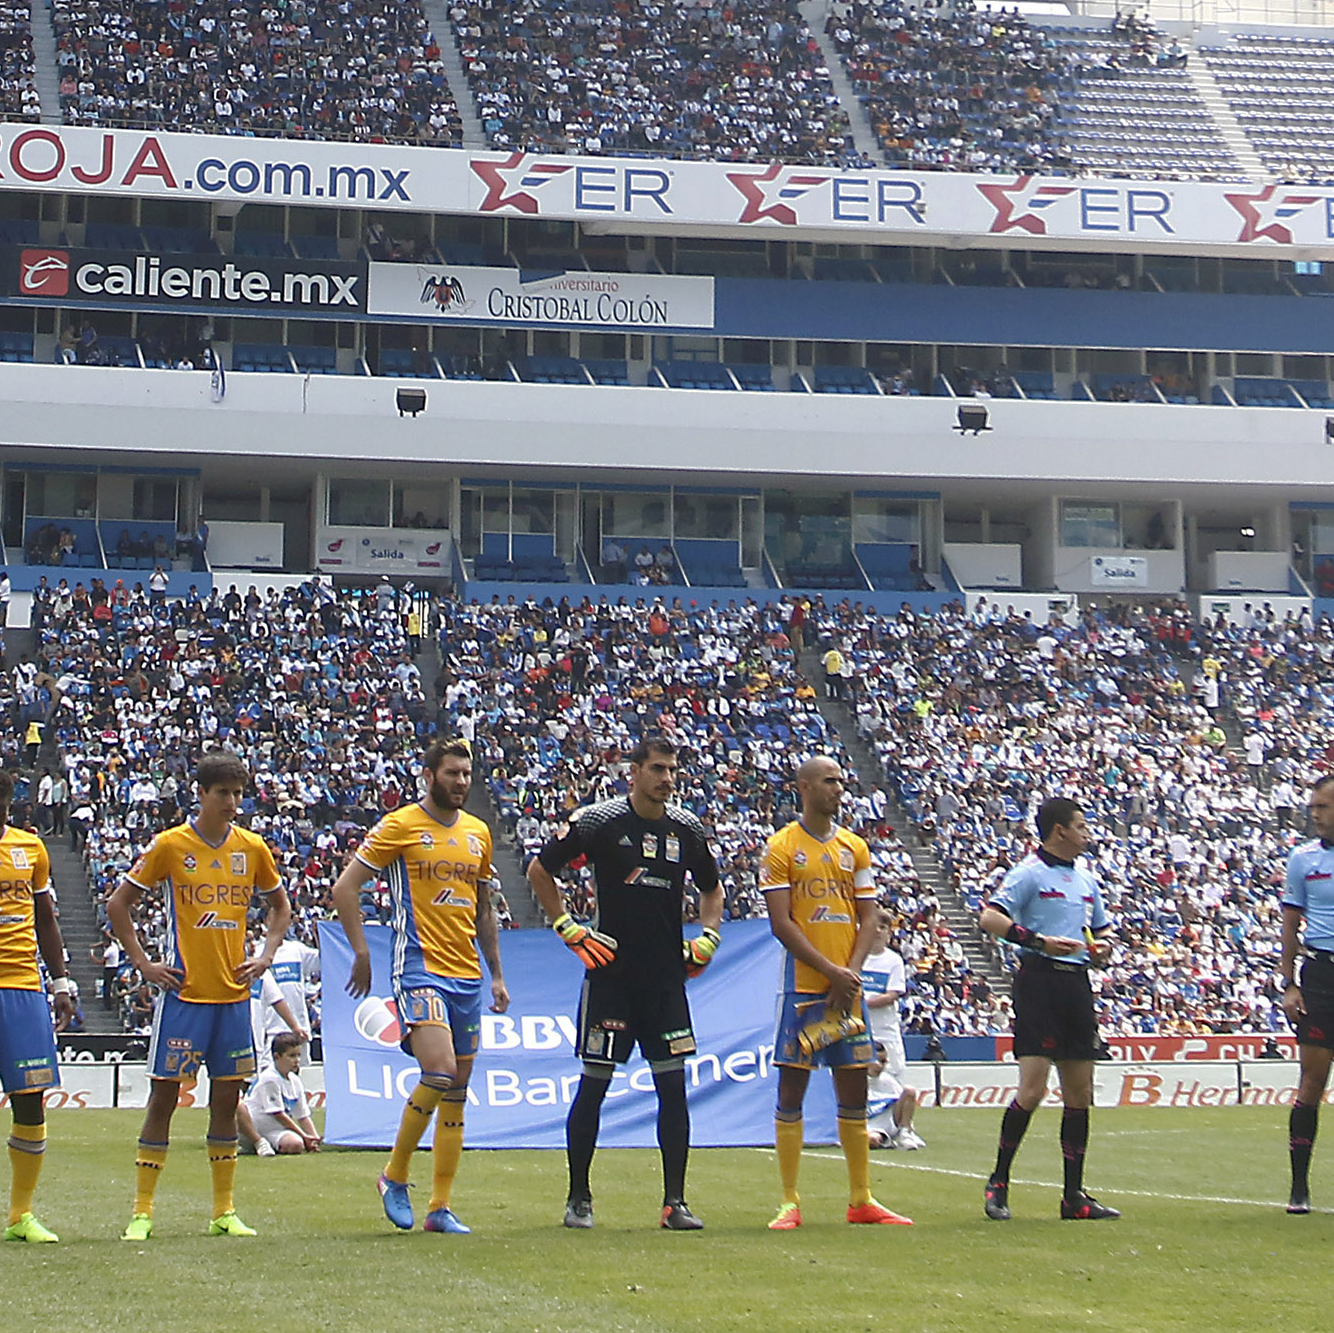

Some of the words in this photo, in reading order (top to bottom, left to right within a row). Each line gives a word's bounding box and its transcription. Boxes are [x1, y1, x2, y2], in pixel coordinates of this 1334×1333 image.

[573, 167, 673, 215] ER
[831, 178, 927, 225] ER
[1079, 188, 1176, 235] ER
[75, 256, 360, 308] caliente.mx
[550, 278, 619, 293] iversitario
[487, 287, 592, 321] CRISTOBAL
[597, 293, 668, 324] COLÓN
[370, 549, 404, 560] Salida
[1104, 568, 1137, 578] Salida
[415, 860, 478, 884] TIGRE
[178, 883, 251, 907] TIGRES
[426, 996, 445, 1022] 10
[481, 1014, 578, 1050] BBV
[606, 1031, 615, 1059] 1
[178, 1050, 203, 1079] 25
[1118, 1073, 1163, 1107] B
